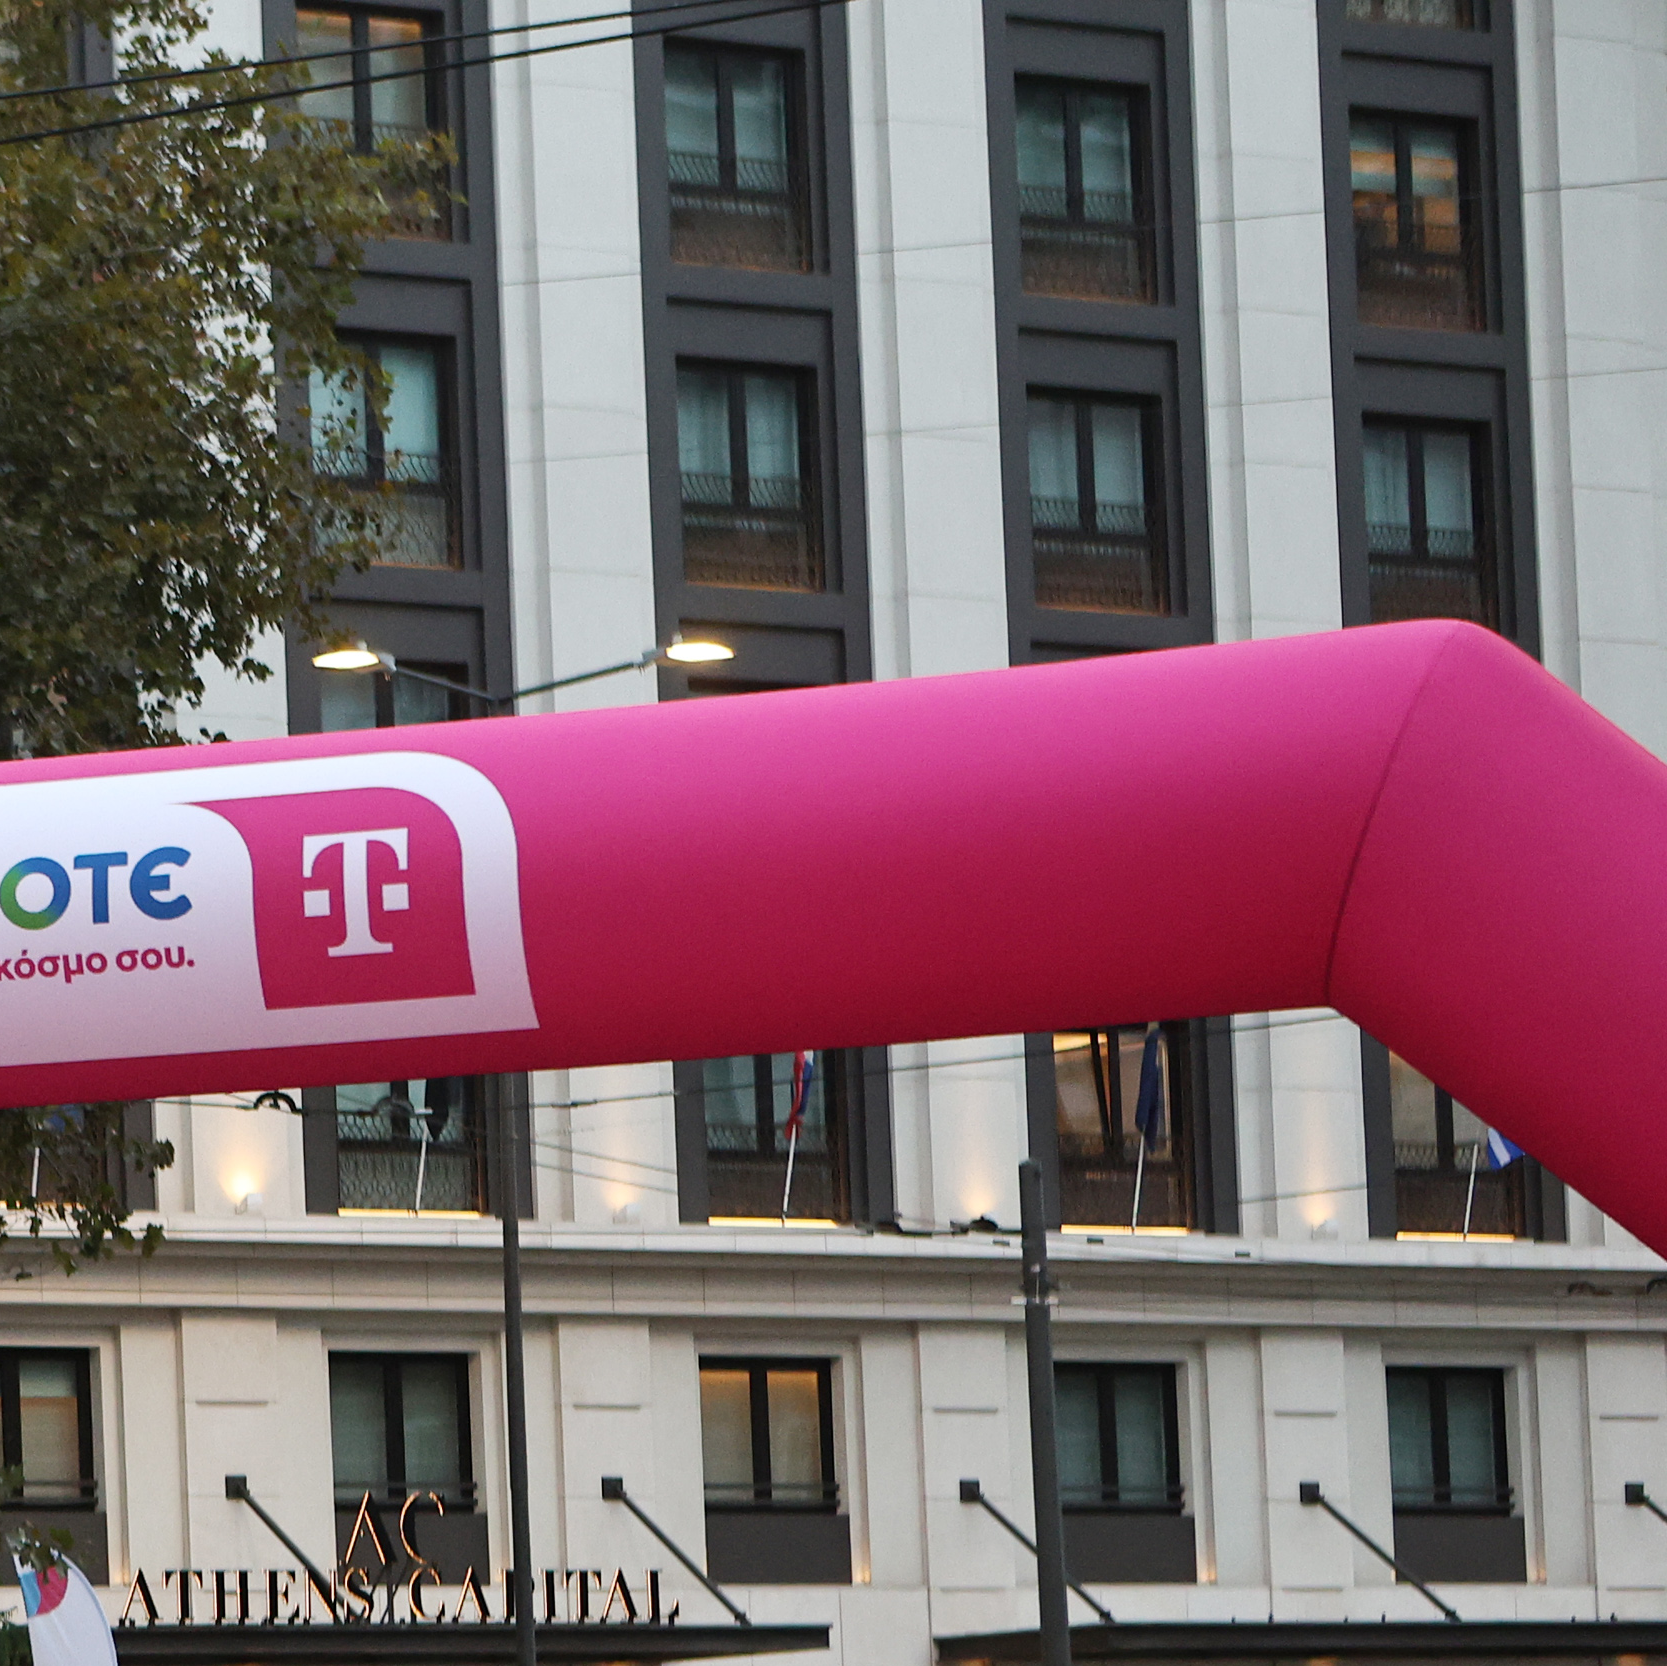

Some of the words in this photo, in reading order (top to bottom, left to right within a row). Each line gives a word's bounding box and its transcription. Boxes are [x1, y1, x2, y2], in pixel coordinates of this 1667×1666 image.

[115, 946, 196, 971] σου.
[341, 1490, 445, 1567] AC
[119, 1567, 370, 1624] ATHENS
